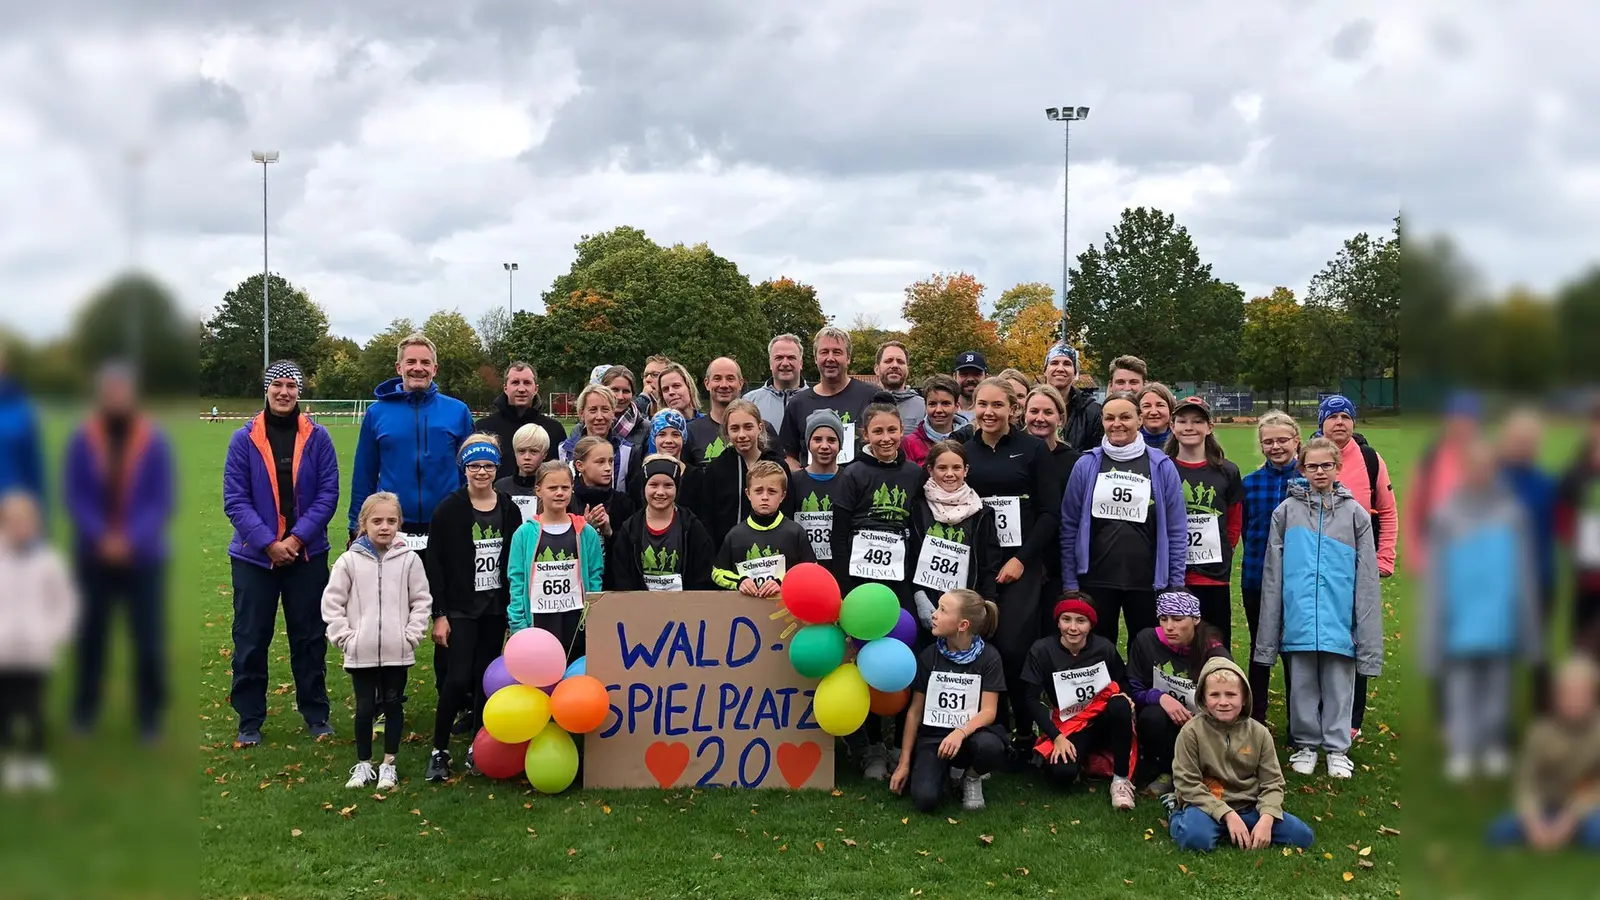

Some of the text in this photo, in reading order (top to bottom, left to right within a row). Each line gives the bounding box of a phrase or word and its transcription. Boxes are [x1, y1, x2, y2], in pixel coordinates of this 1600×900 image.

[1105, 472, 1144, 484] Schweiger
[1112, 487, 1132, 503] 95
[800, 513, 833, 521] Schweige
[1100, 502, 1141, 519] SILENCA
[860, 531, 899, 544] Schweiger
[930, 537, 968, 555] Schweiger
[742, 559, 779, 571] Schweiger
[863, 548, 892, 566] 493
[536, 562, 576, 571] Schweiger
[855, 563, 897, 578] SILENCA
[930, 555, 959, 577] 584
[542, 578, 571, 596] 658
[920, 570, 959, 590] SILENCA
[537, 596, 576, 611] SILENCA
[617, 616, 783, 671] WALD-
[936, 674, 974, 686] Schweiger
[1060, 667, 1100, 681] Schweiger
[938, 691, 966, 710] 631
[1076, 685, 1096, 703] 93
[600, 682, 822, 738] SPIELPLATZ
[696, 736, 771, 788] 2.0
